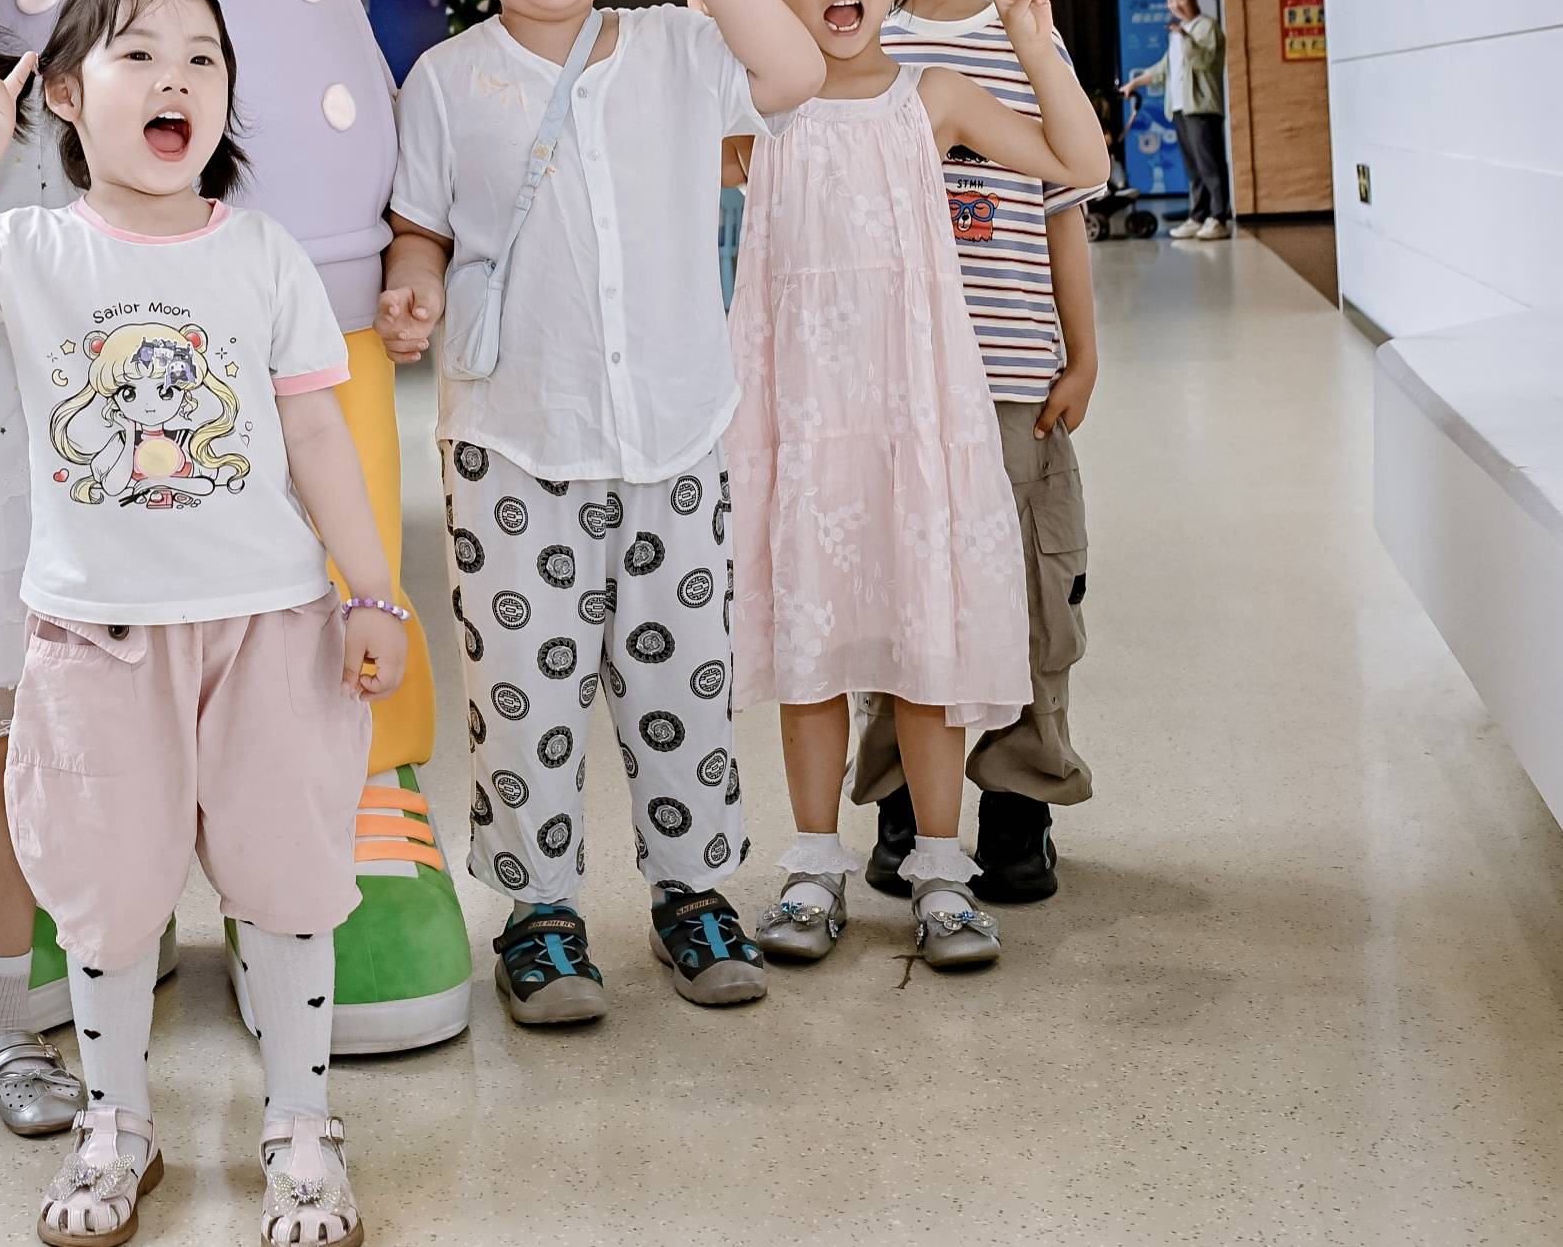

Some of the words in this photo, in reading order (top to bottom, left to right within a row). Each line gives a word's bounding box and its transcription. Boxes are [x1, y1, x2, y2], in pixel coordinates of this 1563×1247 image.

[957, 179, 984, 189] STMH
[92, 302, 140, 324] Sailor
[148, 301, 192, 319] Moon
